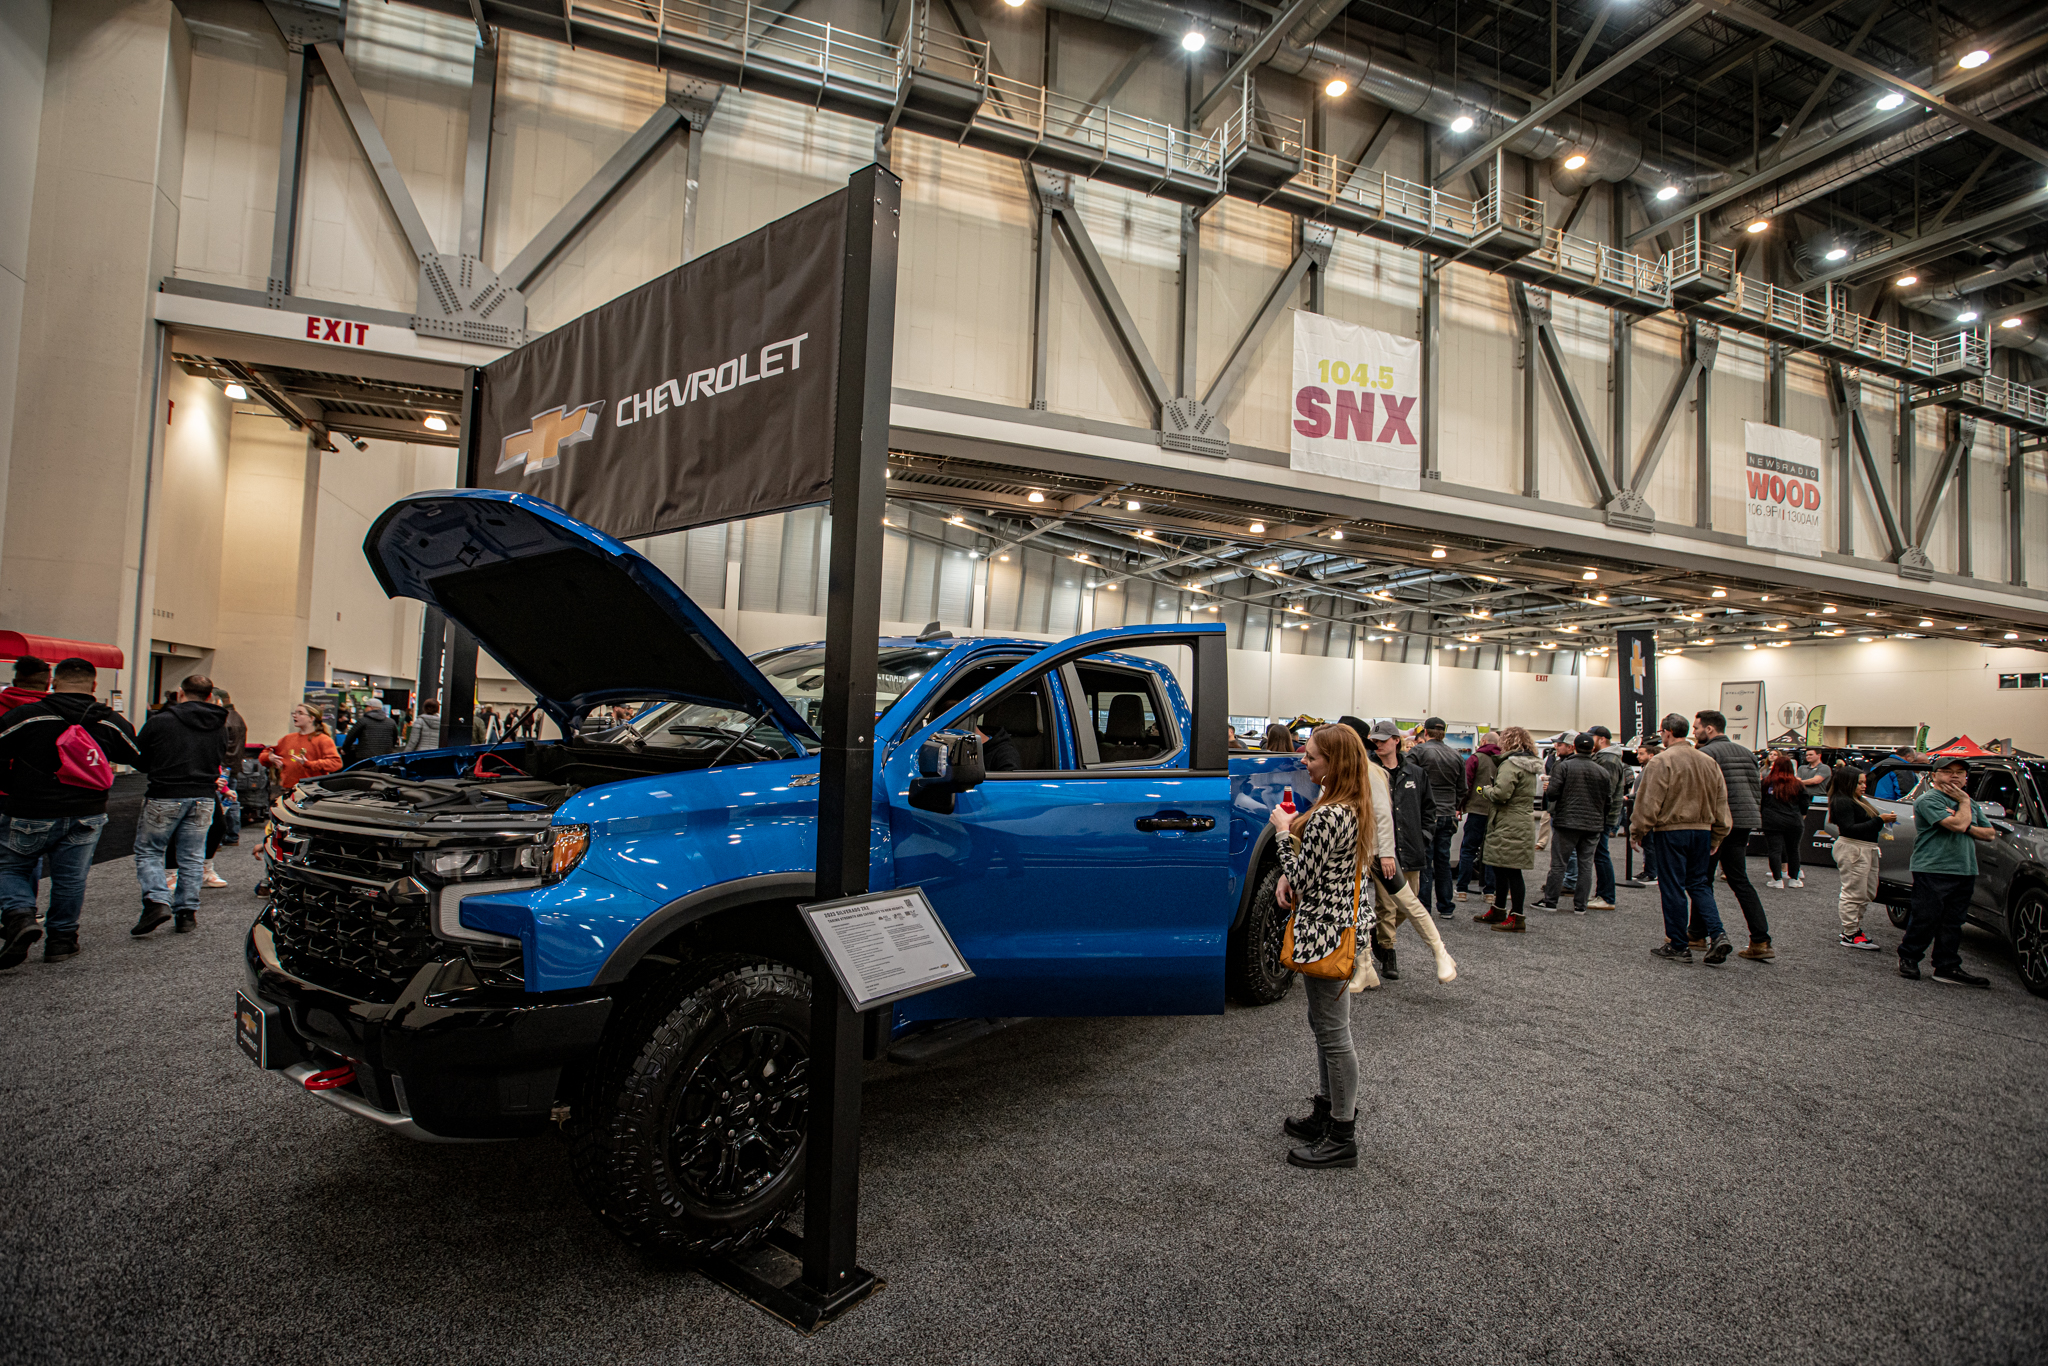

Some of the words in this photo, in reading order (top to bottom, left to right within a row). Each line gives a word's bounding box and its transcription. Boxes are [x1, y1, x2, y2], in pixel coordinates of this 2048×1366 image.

[306, 316, 370, 346] EXIT
[616, 332, 809, 427] CHEVROLET
[1318, 359, 1394, 390] 104.5
[1293, 385, 1418, 445] SNX
[1749, 456, 1816, 478] NEWSRADIO
[1746, 470, 1821, 511] WOOD
[1787, 510, 1819, 526] 1300AM
[1535, 674, 1548, 682] EXIT
[836, 906, 861, 916] SILVERADO
[240, 1029, 258, 1052] CHEVROLET
